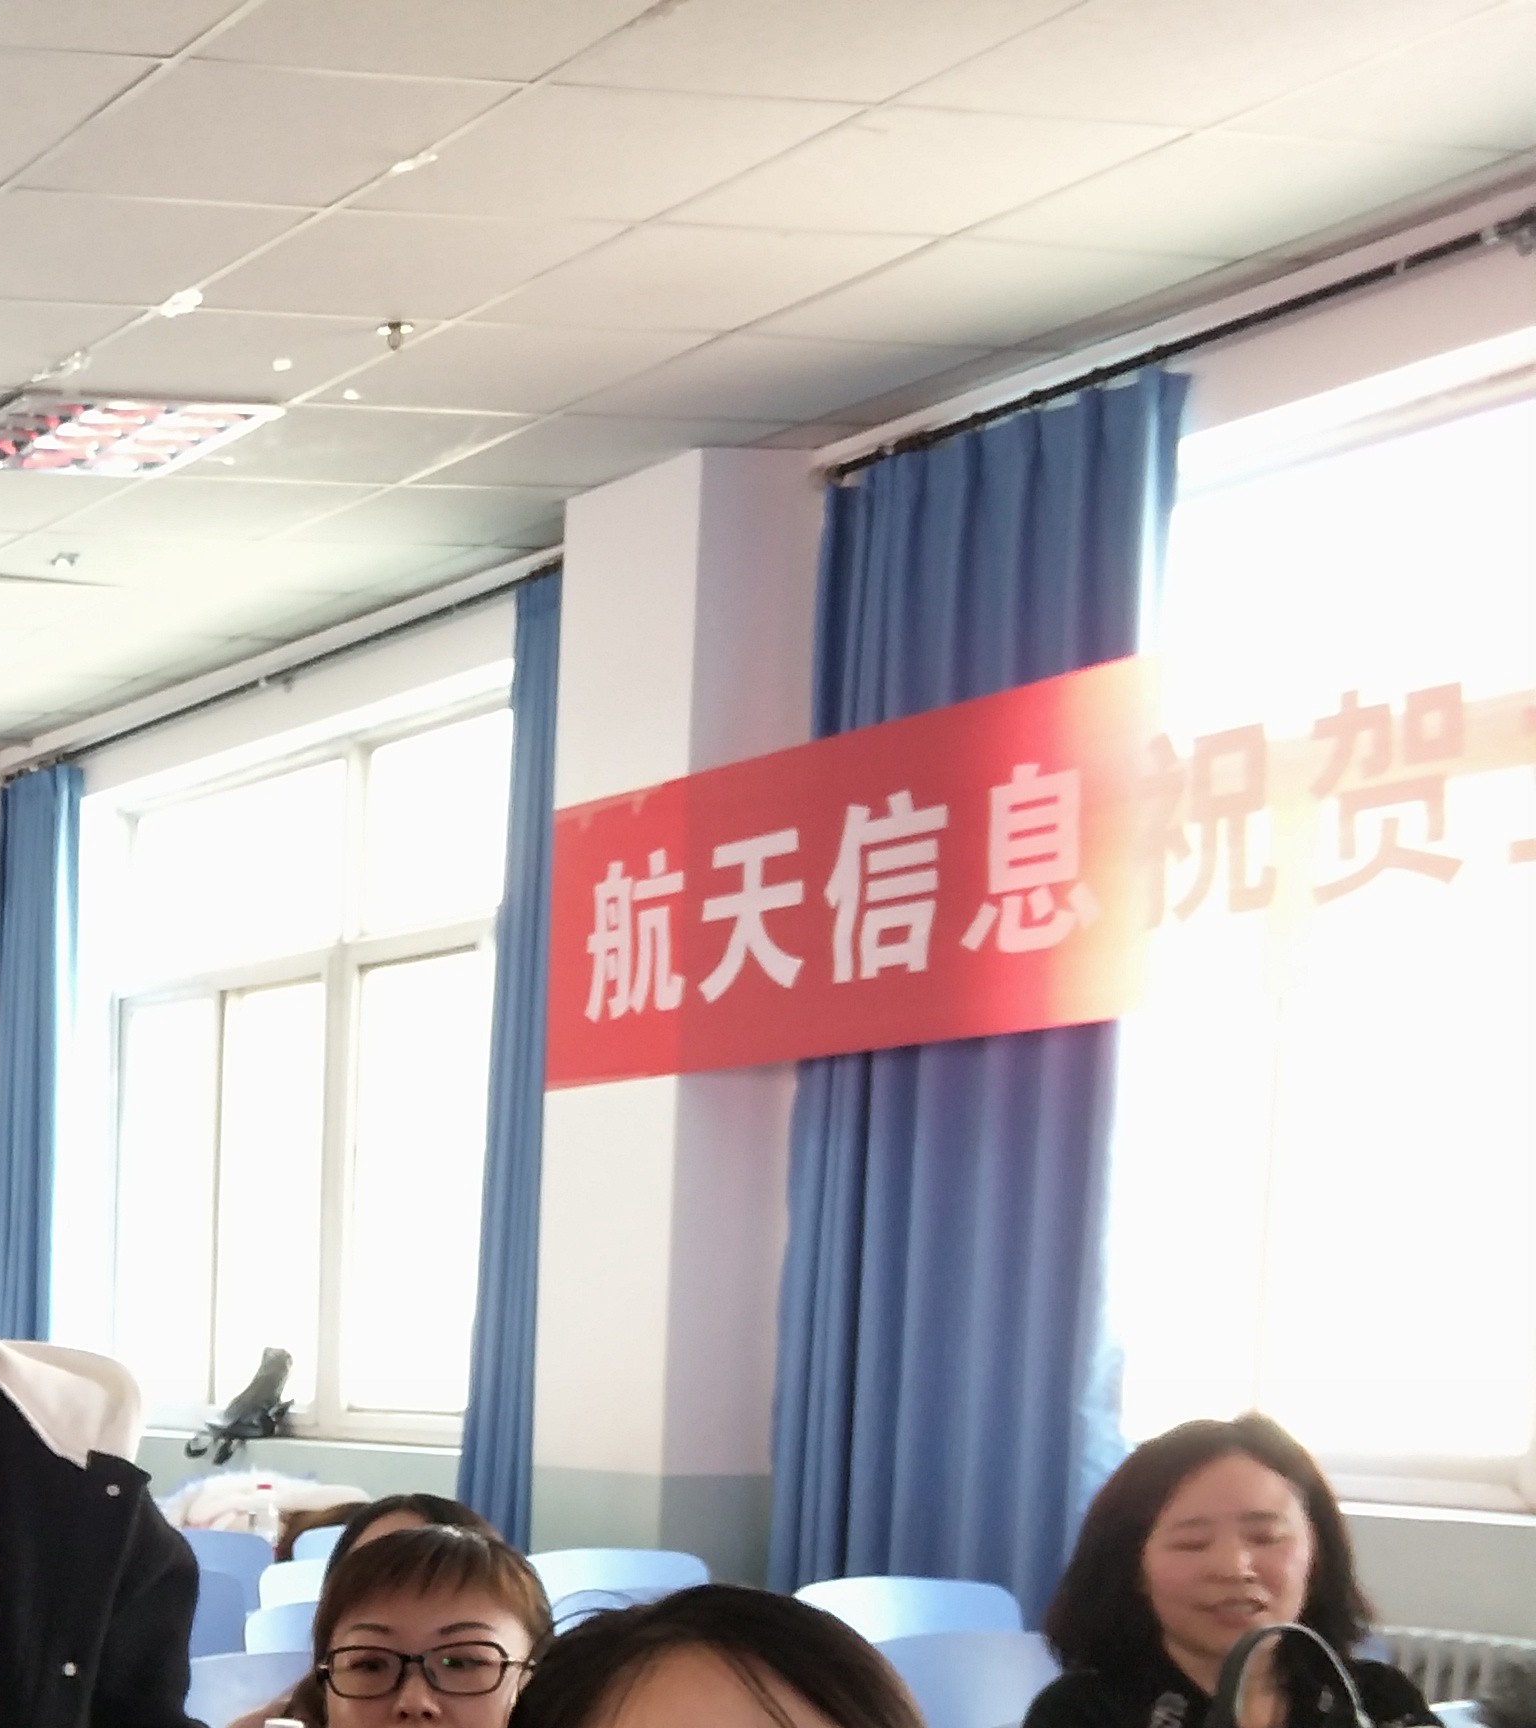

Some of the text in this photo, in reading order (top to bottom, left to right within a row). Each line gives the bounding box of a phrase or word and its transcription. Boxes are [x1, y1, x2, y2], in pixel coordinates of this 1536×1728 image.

[584, 681, 1536, 1022] 航天信息祝贺
